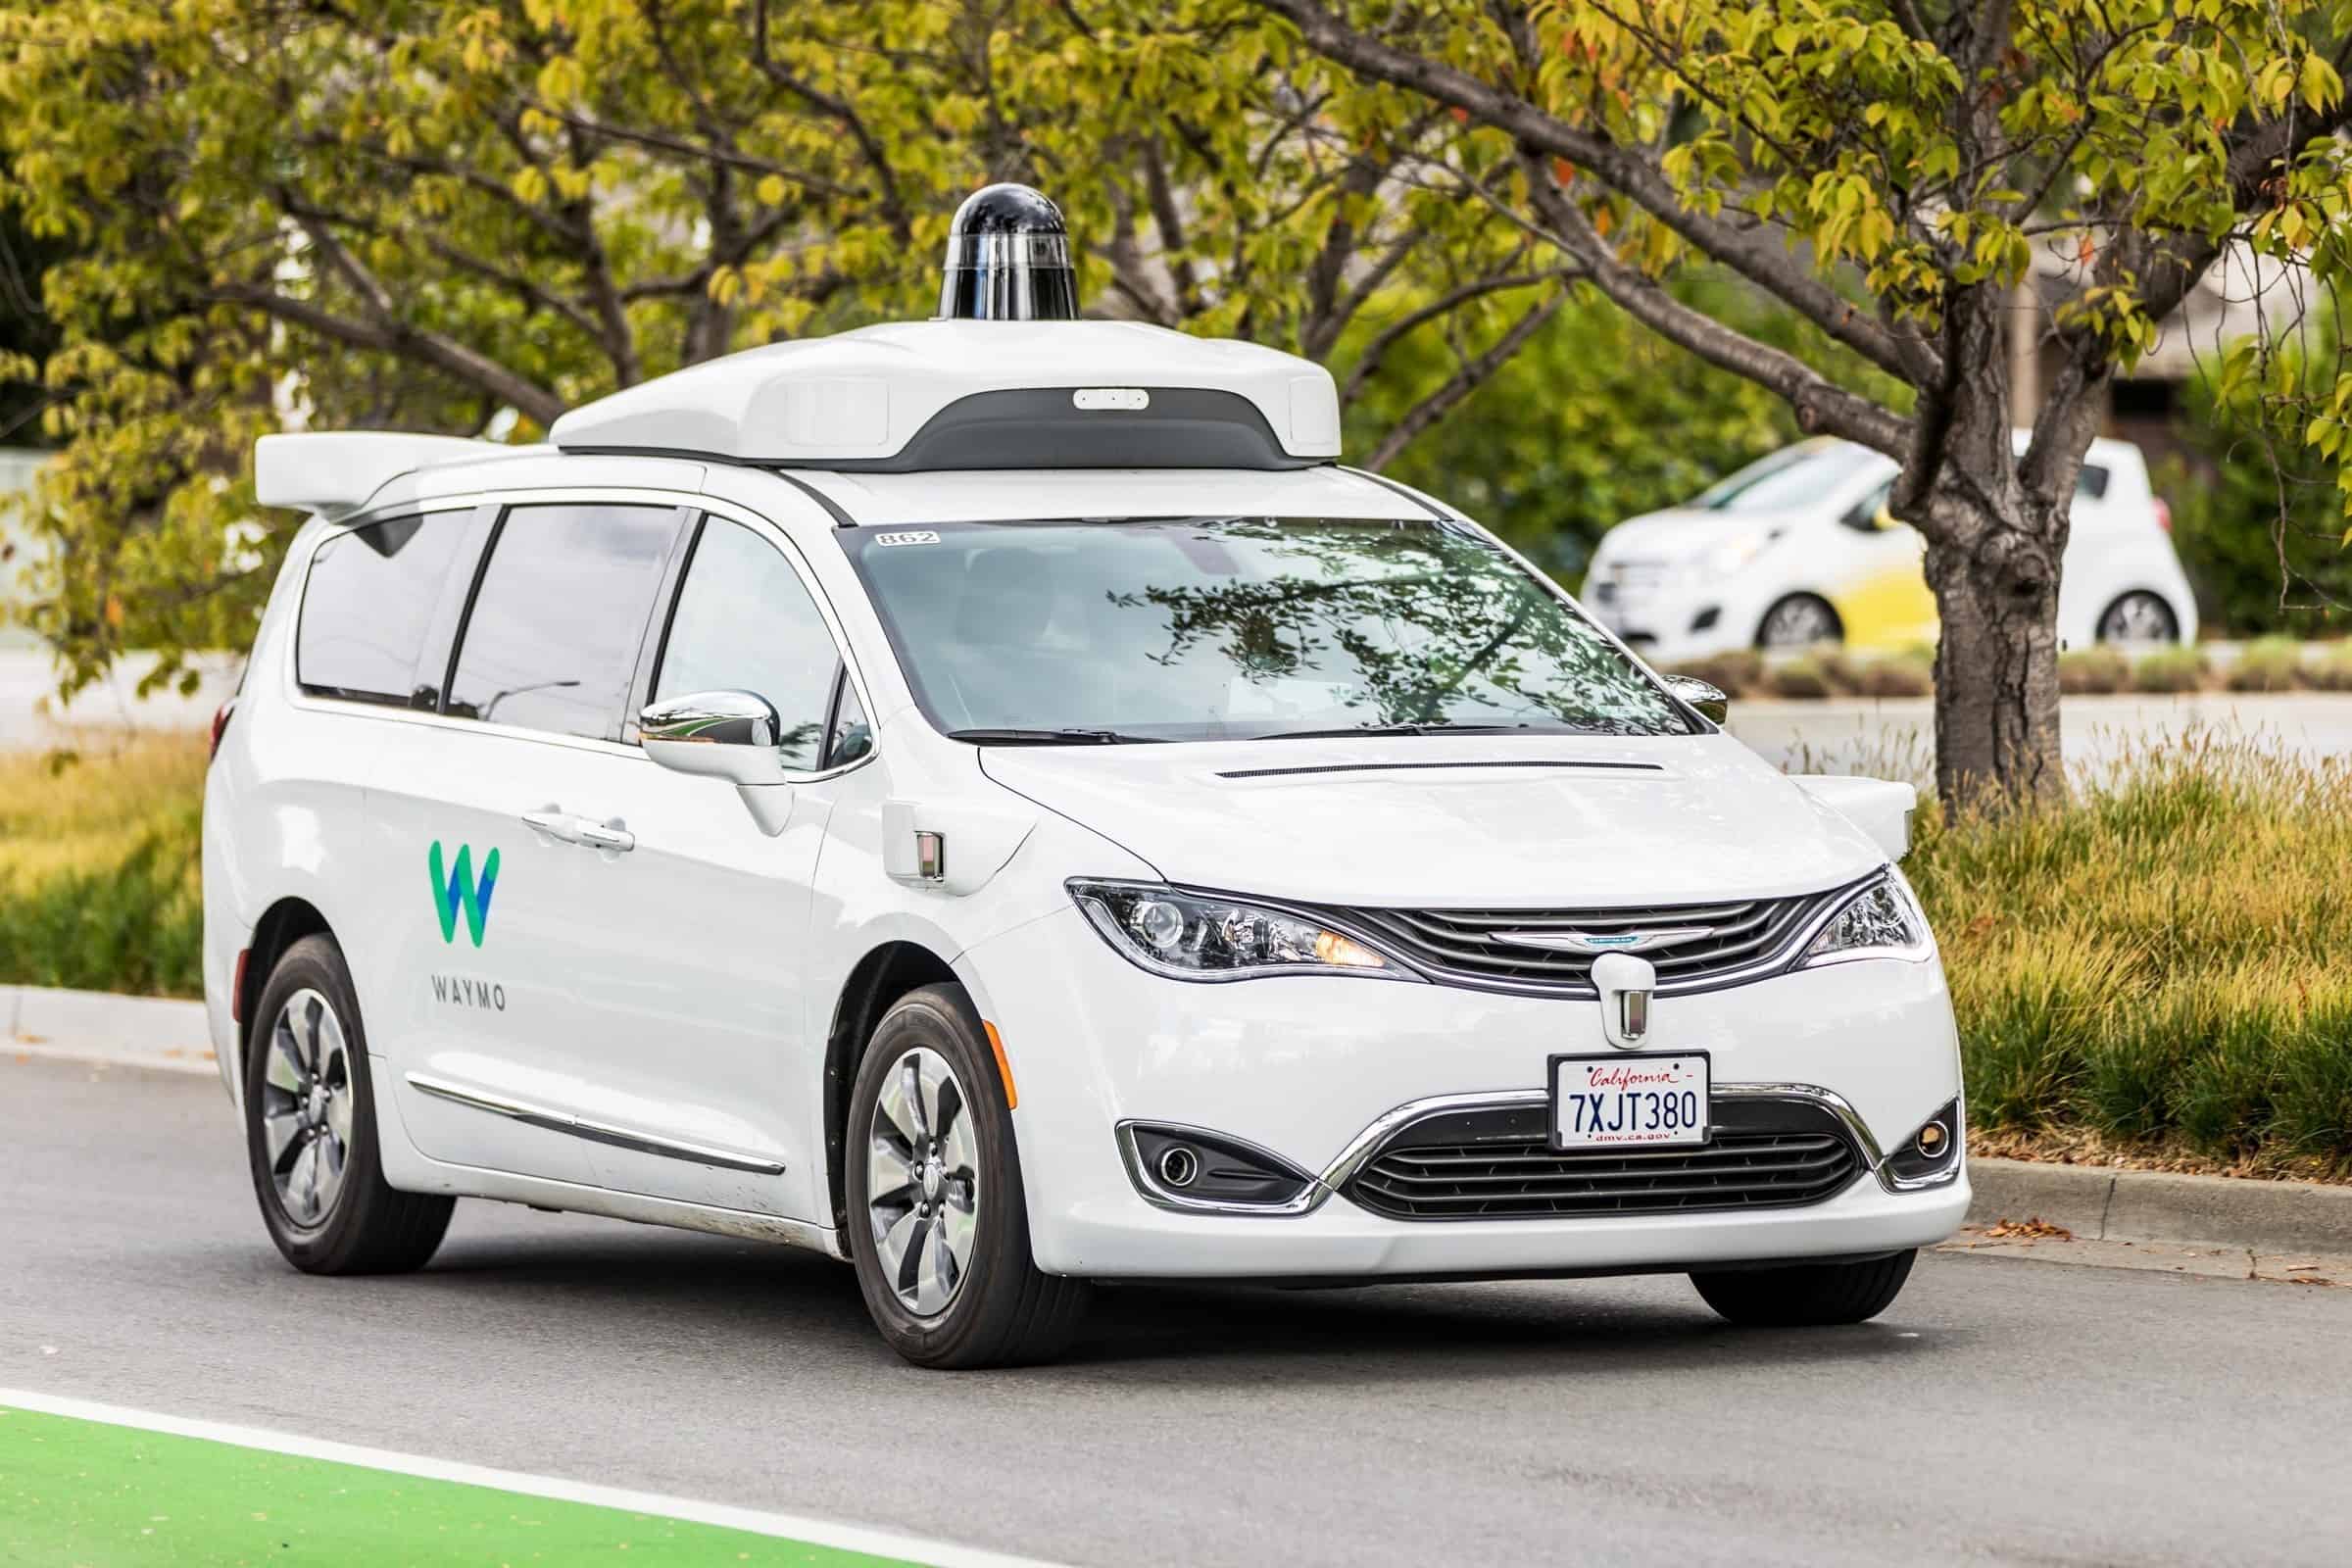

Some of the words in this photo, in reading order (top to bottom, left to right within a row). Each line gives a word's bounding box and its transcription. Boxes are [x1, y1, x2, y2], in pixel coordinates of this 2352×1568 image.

[879, 532, 938, 544] 862
[431, 974, 506, 1011] WAYMO
[1590, 1067, 1679, 1091] California
[1569, 1091, 1696, 1133] 7XJT380
[1595, 1132, 1671, 1143] dmv.ca.gov
